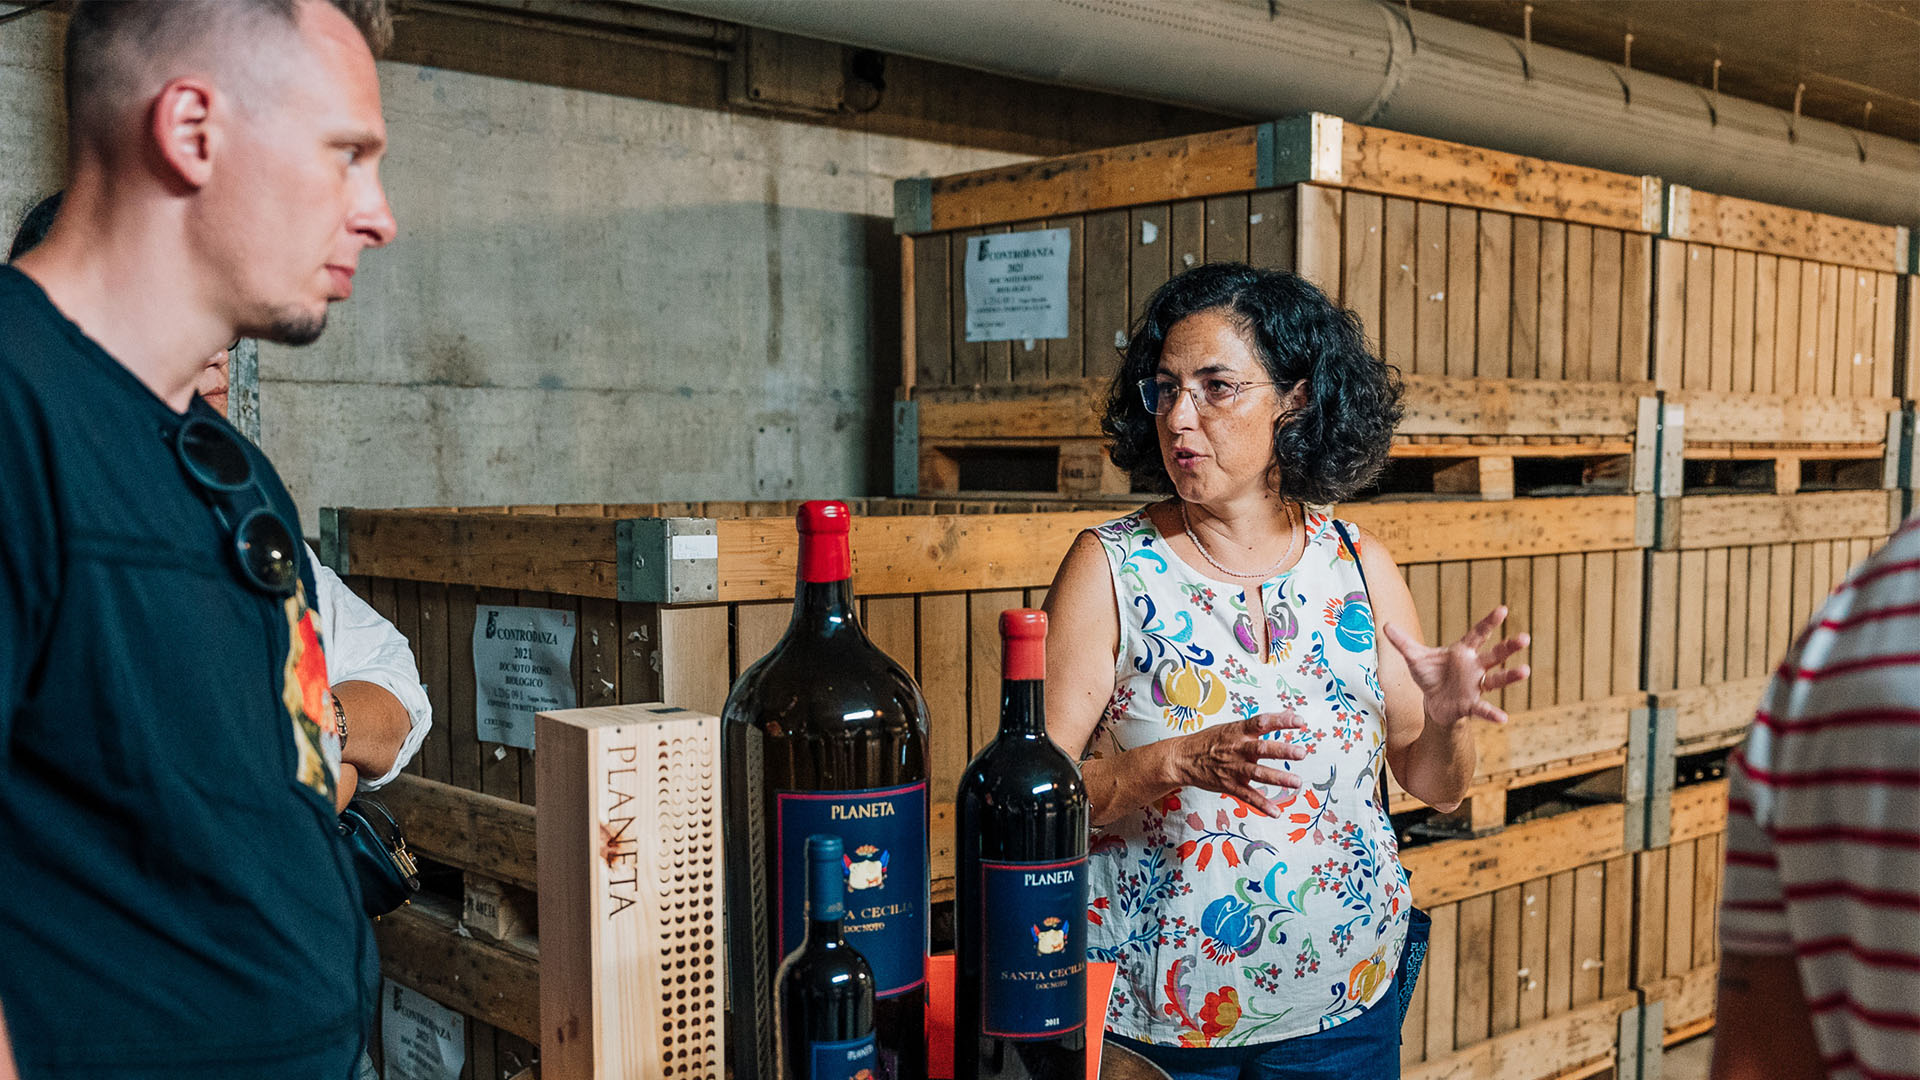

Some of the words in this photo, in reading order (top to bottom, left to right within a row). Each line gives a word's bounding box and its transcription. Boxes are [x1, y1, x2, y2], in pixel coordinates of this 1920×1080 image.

[497, 629, 558, 645] CONTRODANZA
[514, 647, 533, 660] 2021
[499, 662, 511, 671] DOC
[511, 663, 531, 674] NOTO
[531, 665, 552, 676] ROSSO
[505, 675, 544, 688] BIOLOGICO
[831, 801, 896, 820] PLANETA
[608, 745, 638, 921] PLANETA
[1024, 870, 1075, 887] PLANETA
[862, 921, 886, 932] NOTO
[1001, 970, 1046, 981] SANTA
[1036, 982, 1050, 990] DOC
[1044, 1017, 1060, 1027] 2011
